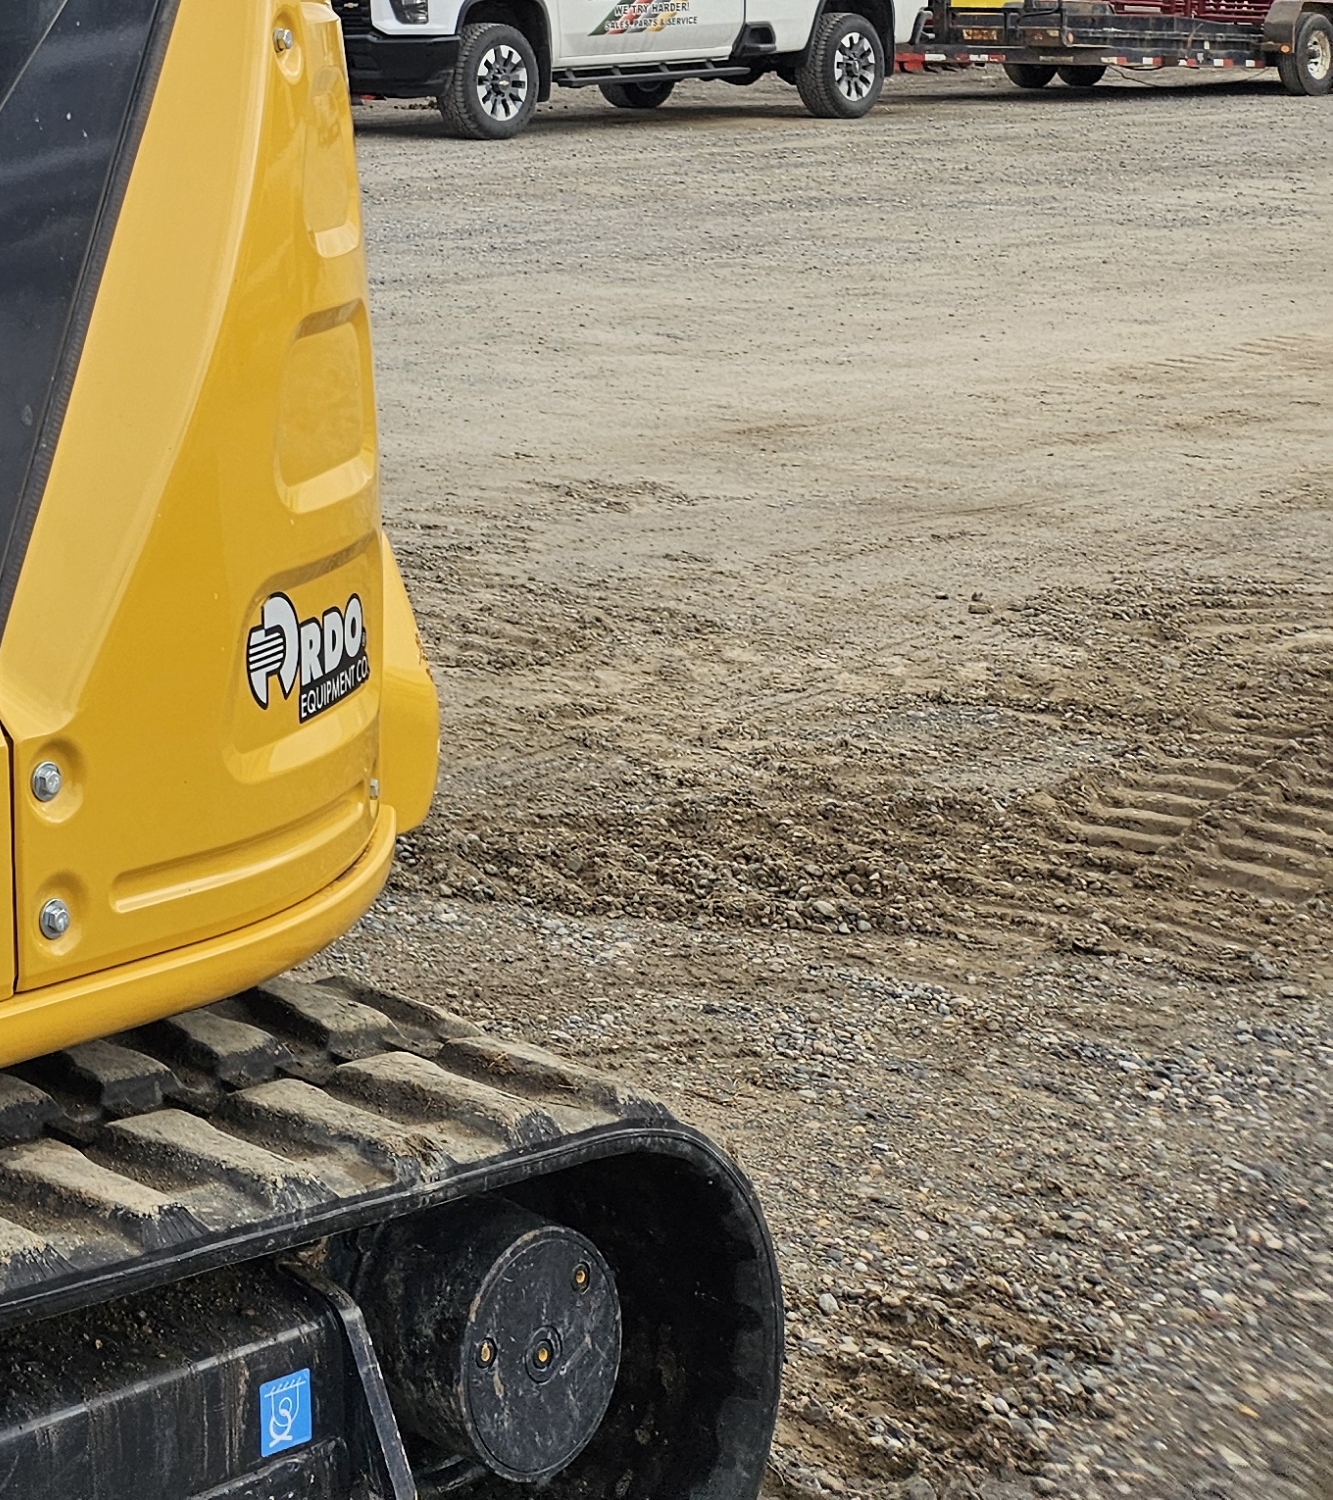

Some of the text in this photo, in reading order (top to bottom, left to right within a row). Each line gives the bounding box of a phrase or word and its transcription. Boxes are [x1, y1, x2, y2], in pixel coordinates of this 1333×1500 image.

[614, 2, 690, 16] WE TRY HARDER!
[634, 18, 659, 28] PARTS
[660, 17, 665, 26] &
[667, 16, 698, 26] SERVICE
[300, 597, 363, 687] RDO
[301, 664, 356, 719] EQUIPMENT
